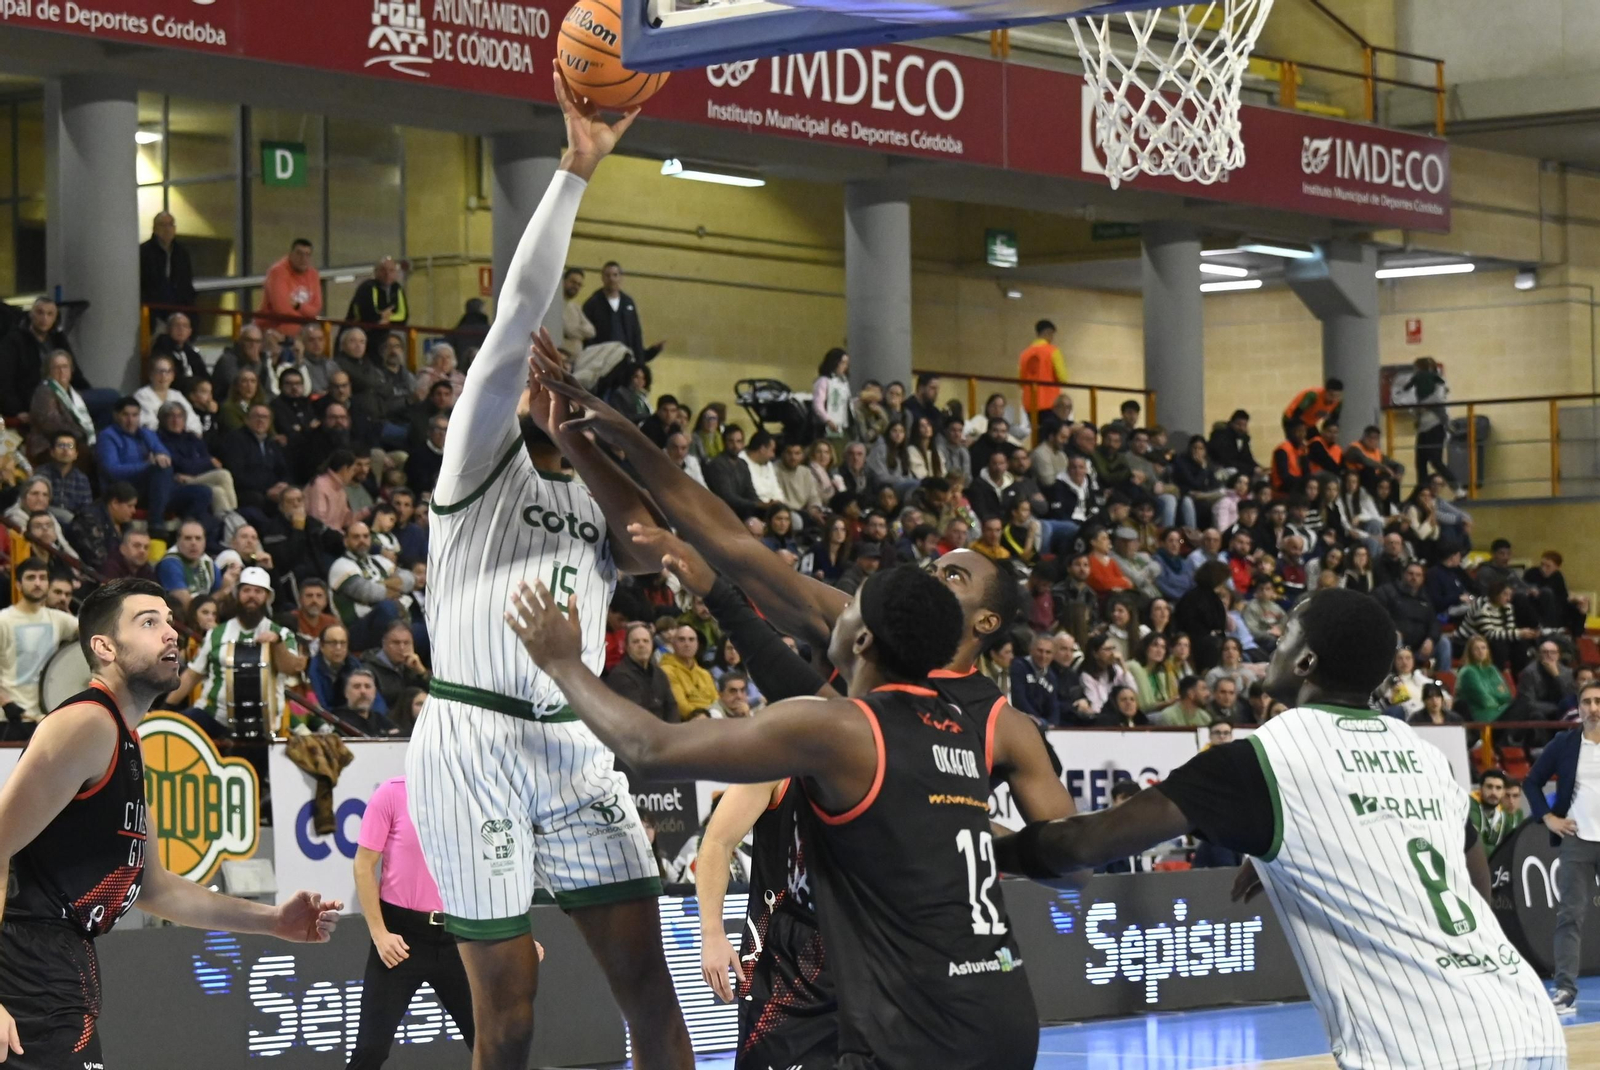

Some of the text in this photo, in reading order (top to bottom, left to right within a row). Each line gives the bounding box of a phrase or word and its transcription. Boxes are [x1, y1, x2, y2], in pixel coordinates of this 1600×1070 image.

[36, 0, 61, 22] de
[65, 2, 149, 33] Deportes
[152, 15, 227, 46] Córdoba
[432, 0, 551, 40] AYUNTAMIENTO
[433, 30, 534, 74] DE CÓRDOBA
[770, 47, 964, 121] IMDECO
[707, 99, 964, 154] Instituto Municipal de Deportes Córdoba
[275, 148, 294, 179] D
[1334, 137, 1444, 194] IMDECO
[1301, 181, 1332, 198] Instituto
[1333, 186, 1369, 206] Municipal
[1380, 195, 1412, 210] Deportes
[523, 505, 599, 544] coto
[932, 744, 980, 779] OKAFOR
[1336, 749, 1422, 774] LAMINE
[956, 829, 1008, 935] 12
[1406, 836, 1477, 937] 8
[1086, 898, 1262, 1003] Sepisur
